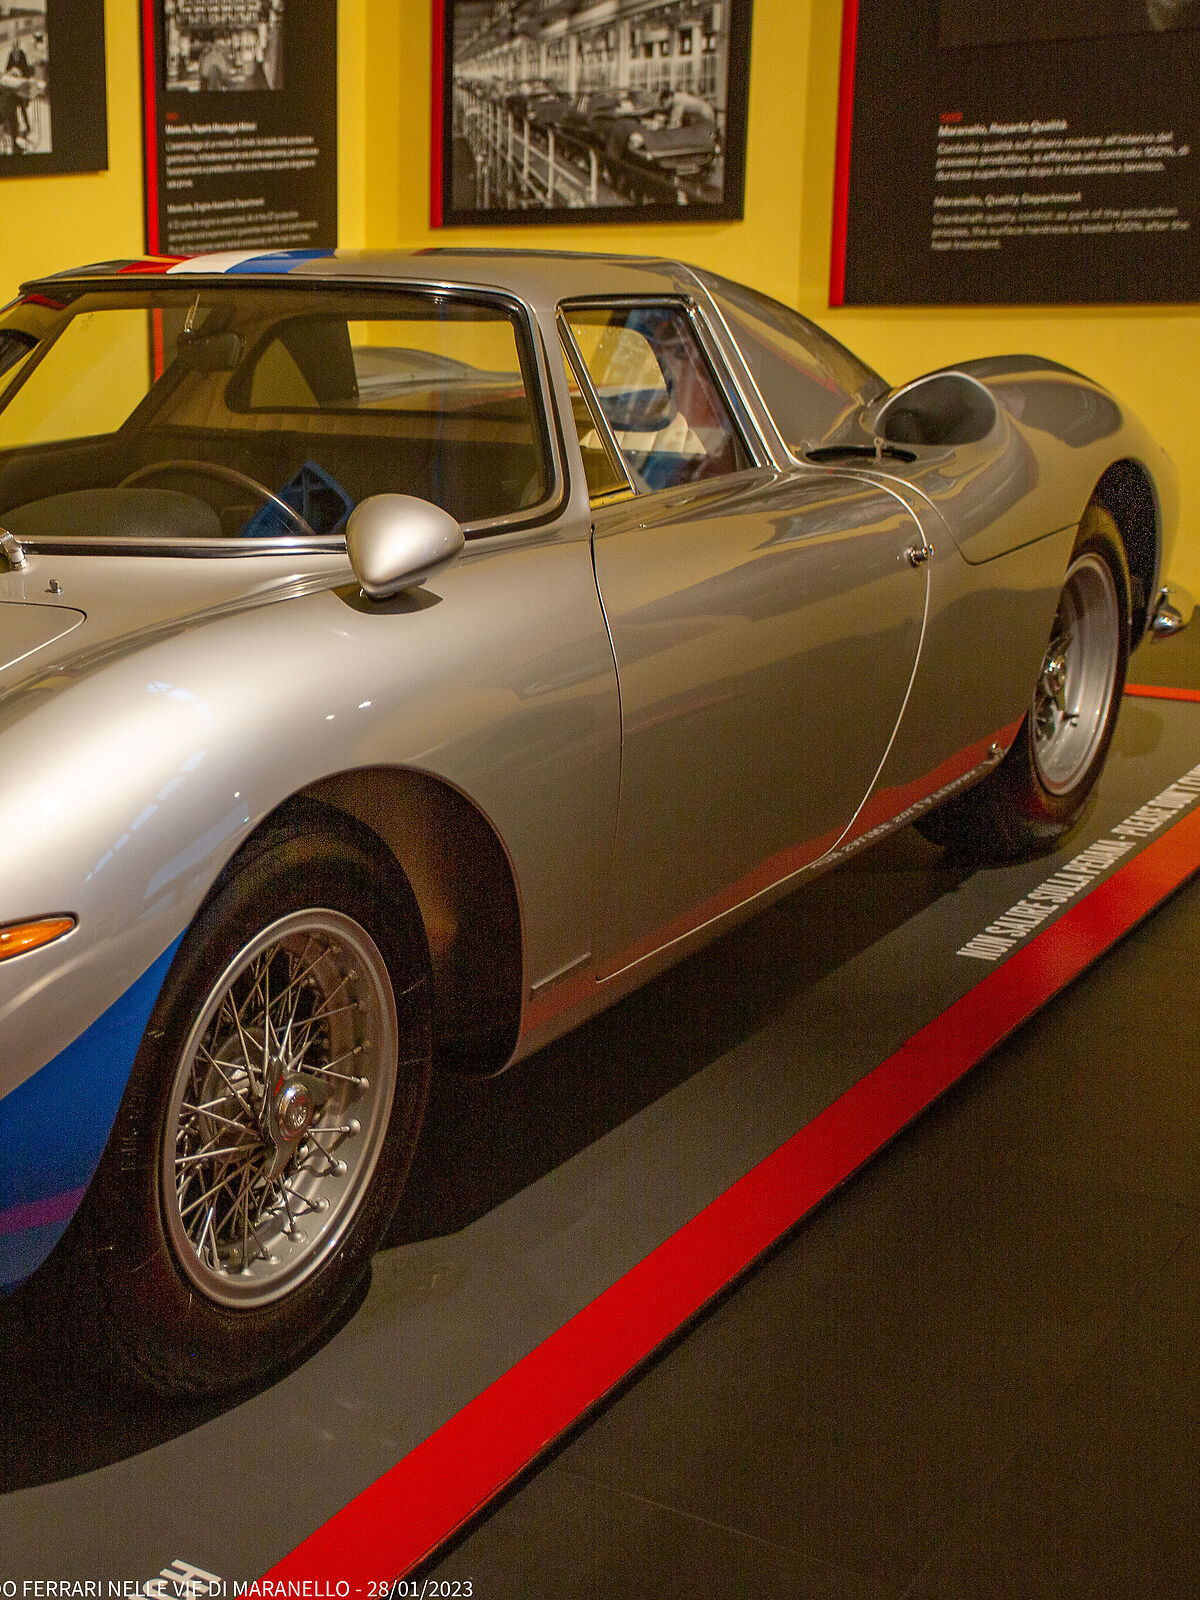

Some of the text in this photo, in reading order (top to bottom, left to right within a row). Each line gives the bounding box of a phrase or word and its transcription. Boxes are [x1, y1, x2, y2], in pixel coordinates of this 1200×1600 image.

[1111, 805, 1179, 837] PLEASE
[1061, 839, 1137, 876] PEDANA
[1027, 872, 1096, 905] SULLA
[985, 900, 1060, 938] SALIRE
[956, 933, 1018, 961] NON
